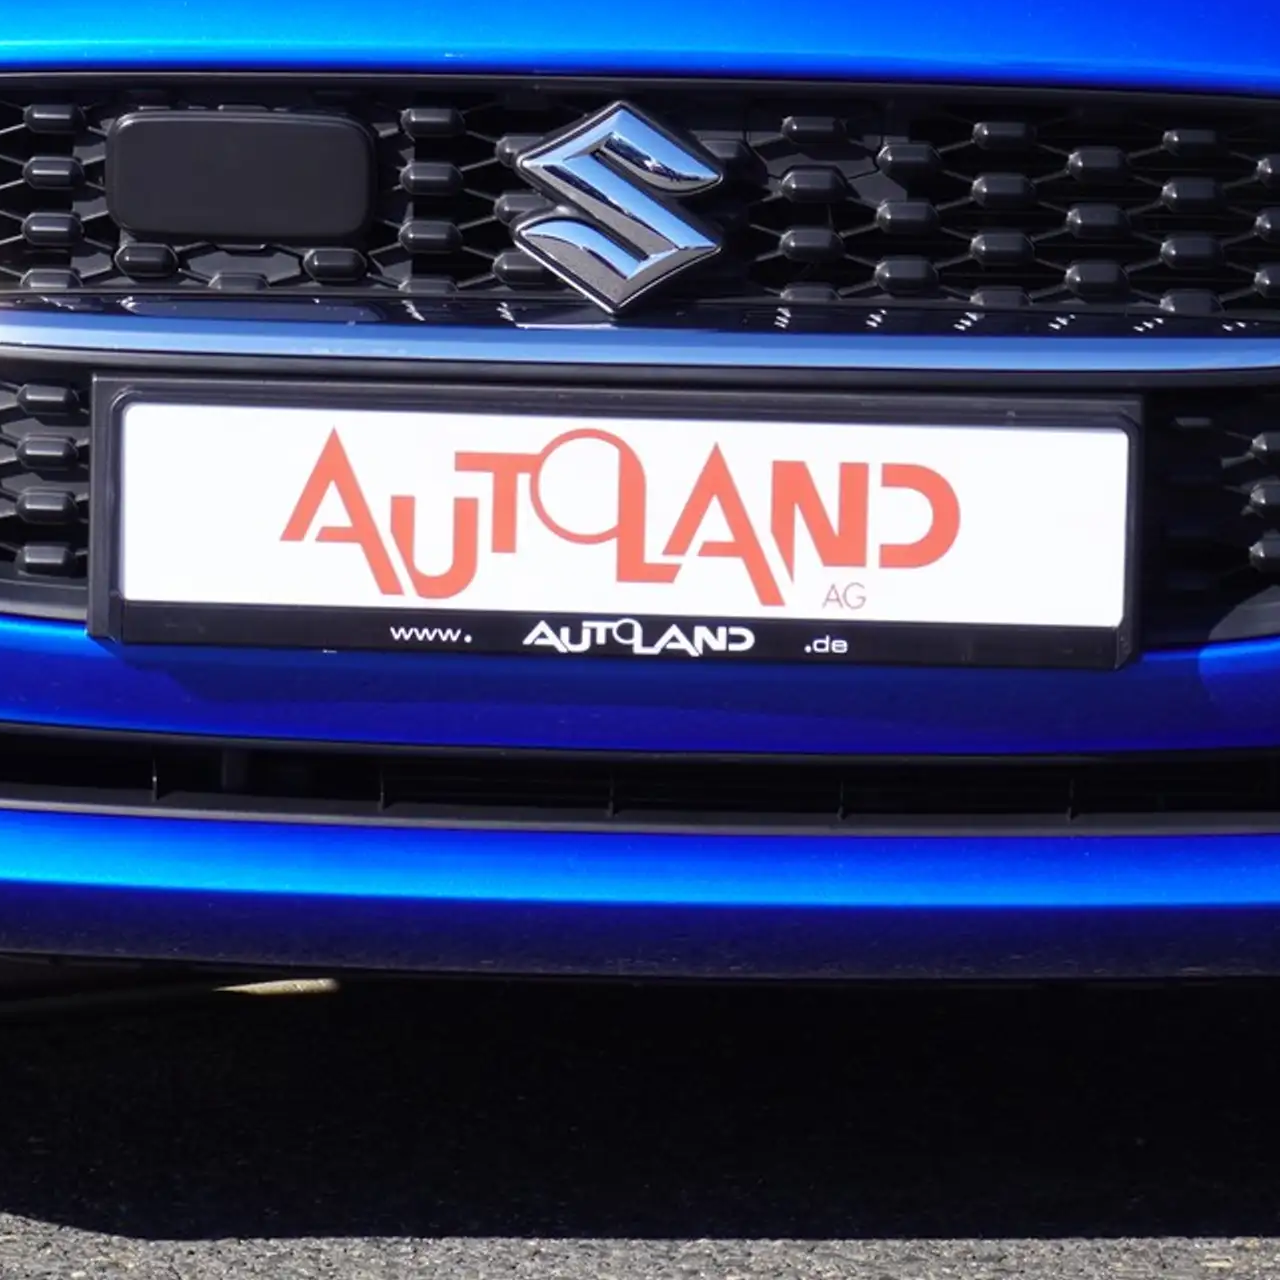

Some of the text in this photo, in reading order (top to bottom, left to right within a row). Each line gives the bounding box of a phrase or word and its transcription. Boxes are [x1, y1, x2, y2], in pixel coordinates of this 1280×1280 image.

[283, 429, 959, 606] AUTOLAND
[822, 582, 867, 609] AG
[389, 618, 848, 656] www. AUTOLAND .de
